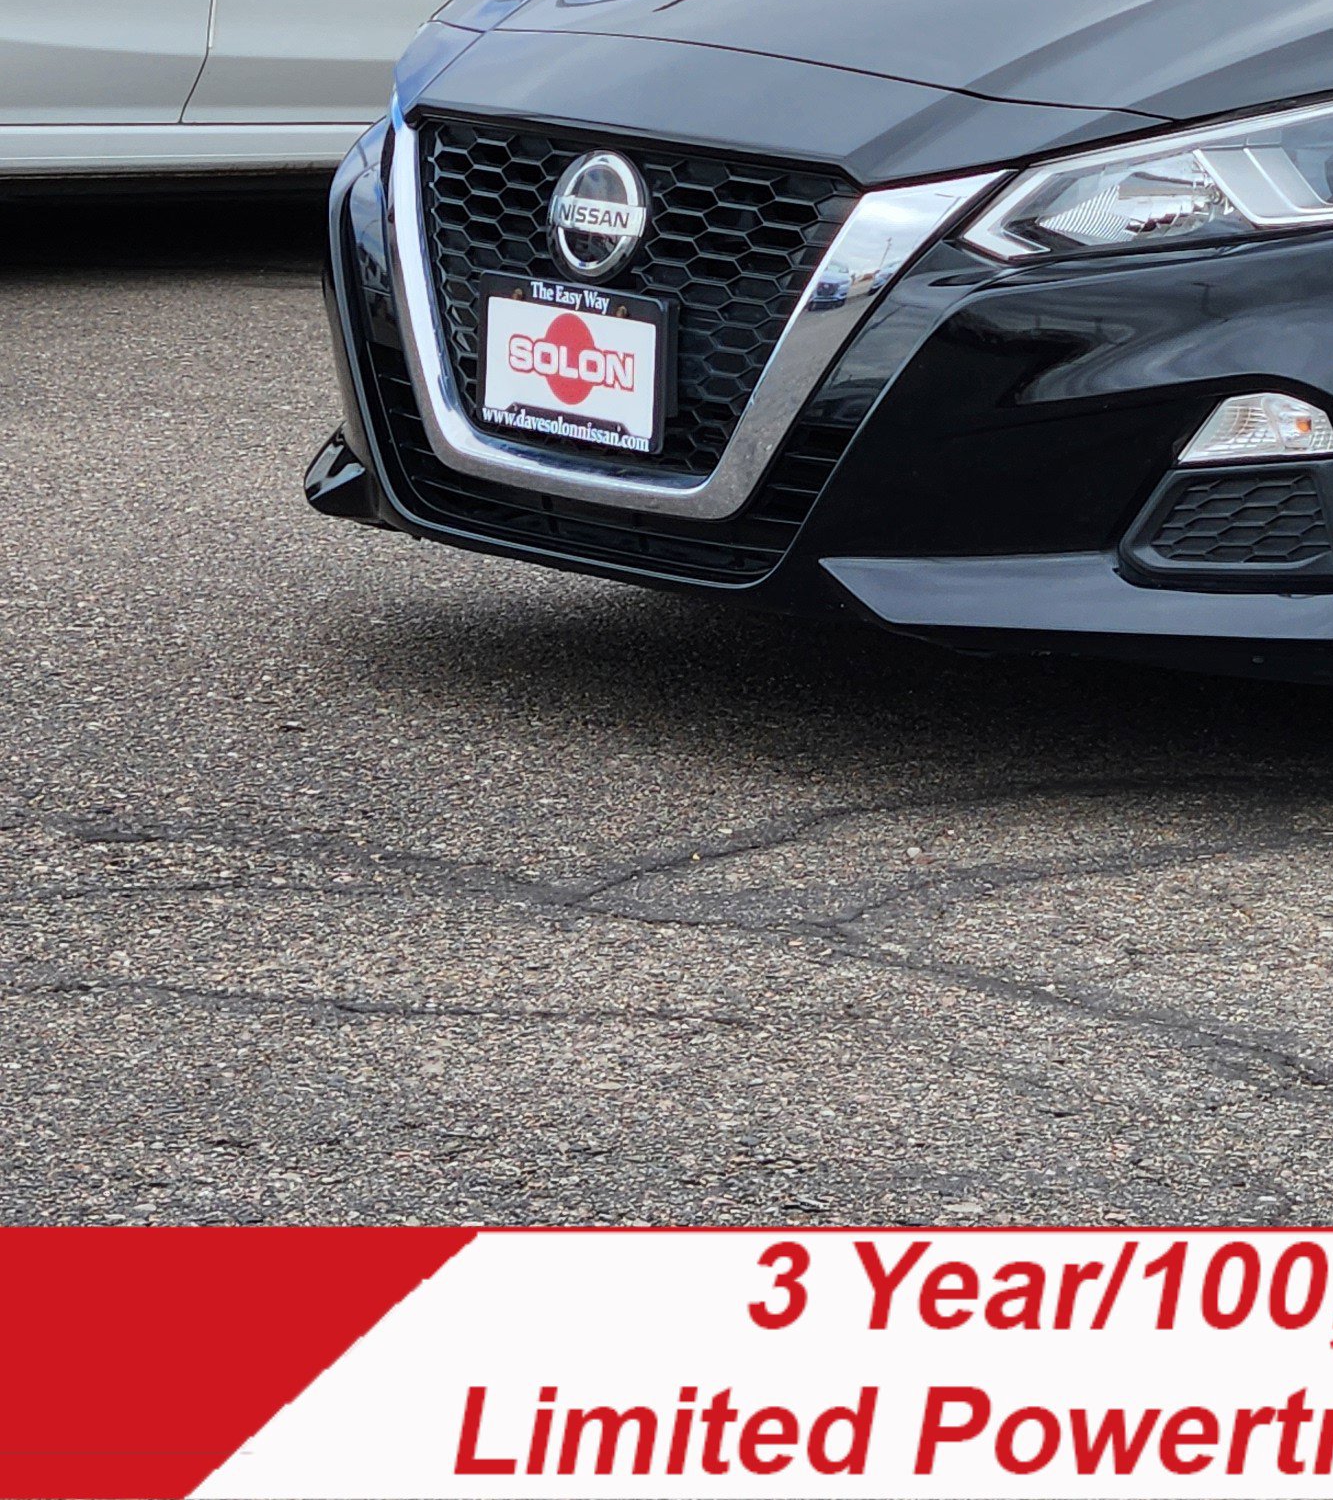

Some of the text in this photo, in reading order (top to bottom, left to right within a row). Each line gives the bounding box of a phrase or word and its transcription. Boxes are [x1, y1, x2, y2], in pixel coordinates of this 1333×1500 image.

[559, 202, 630, 229] NISSAN
[530, 281, 610, 315] The Easy Way
[509, 333, 635, 392] SOLON
[482, 407, 650, 452] www.davesolonnissan.com
